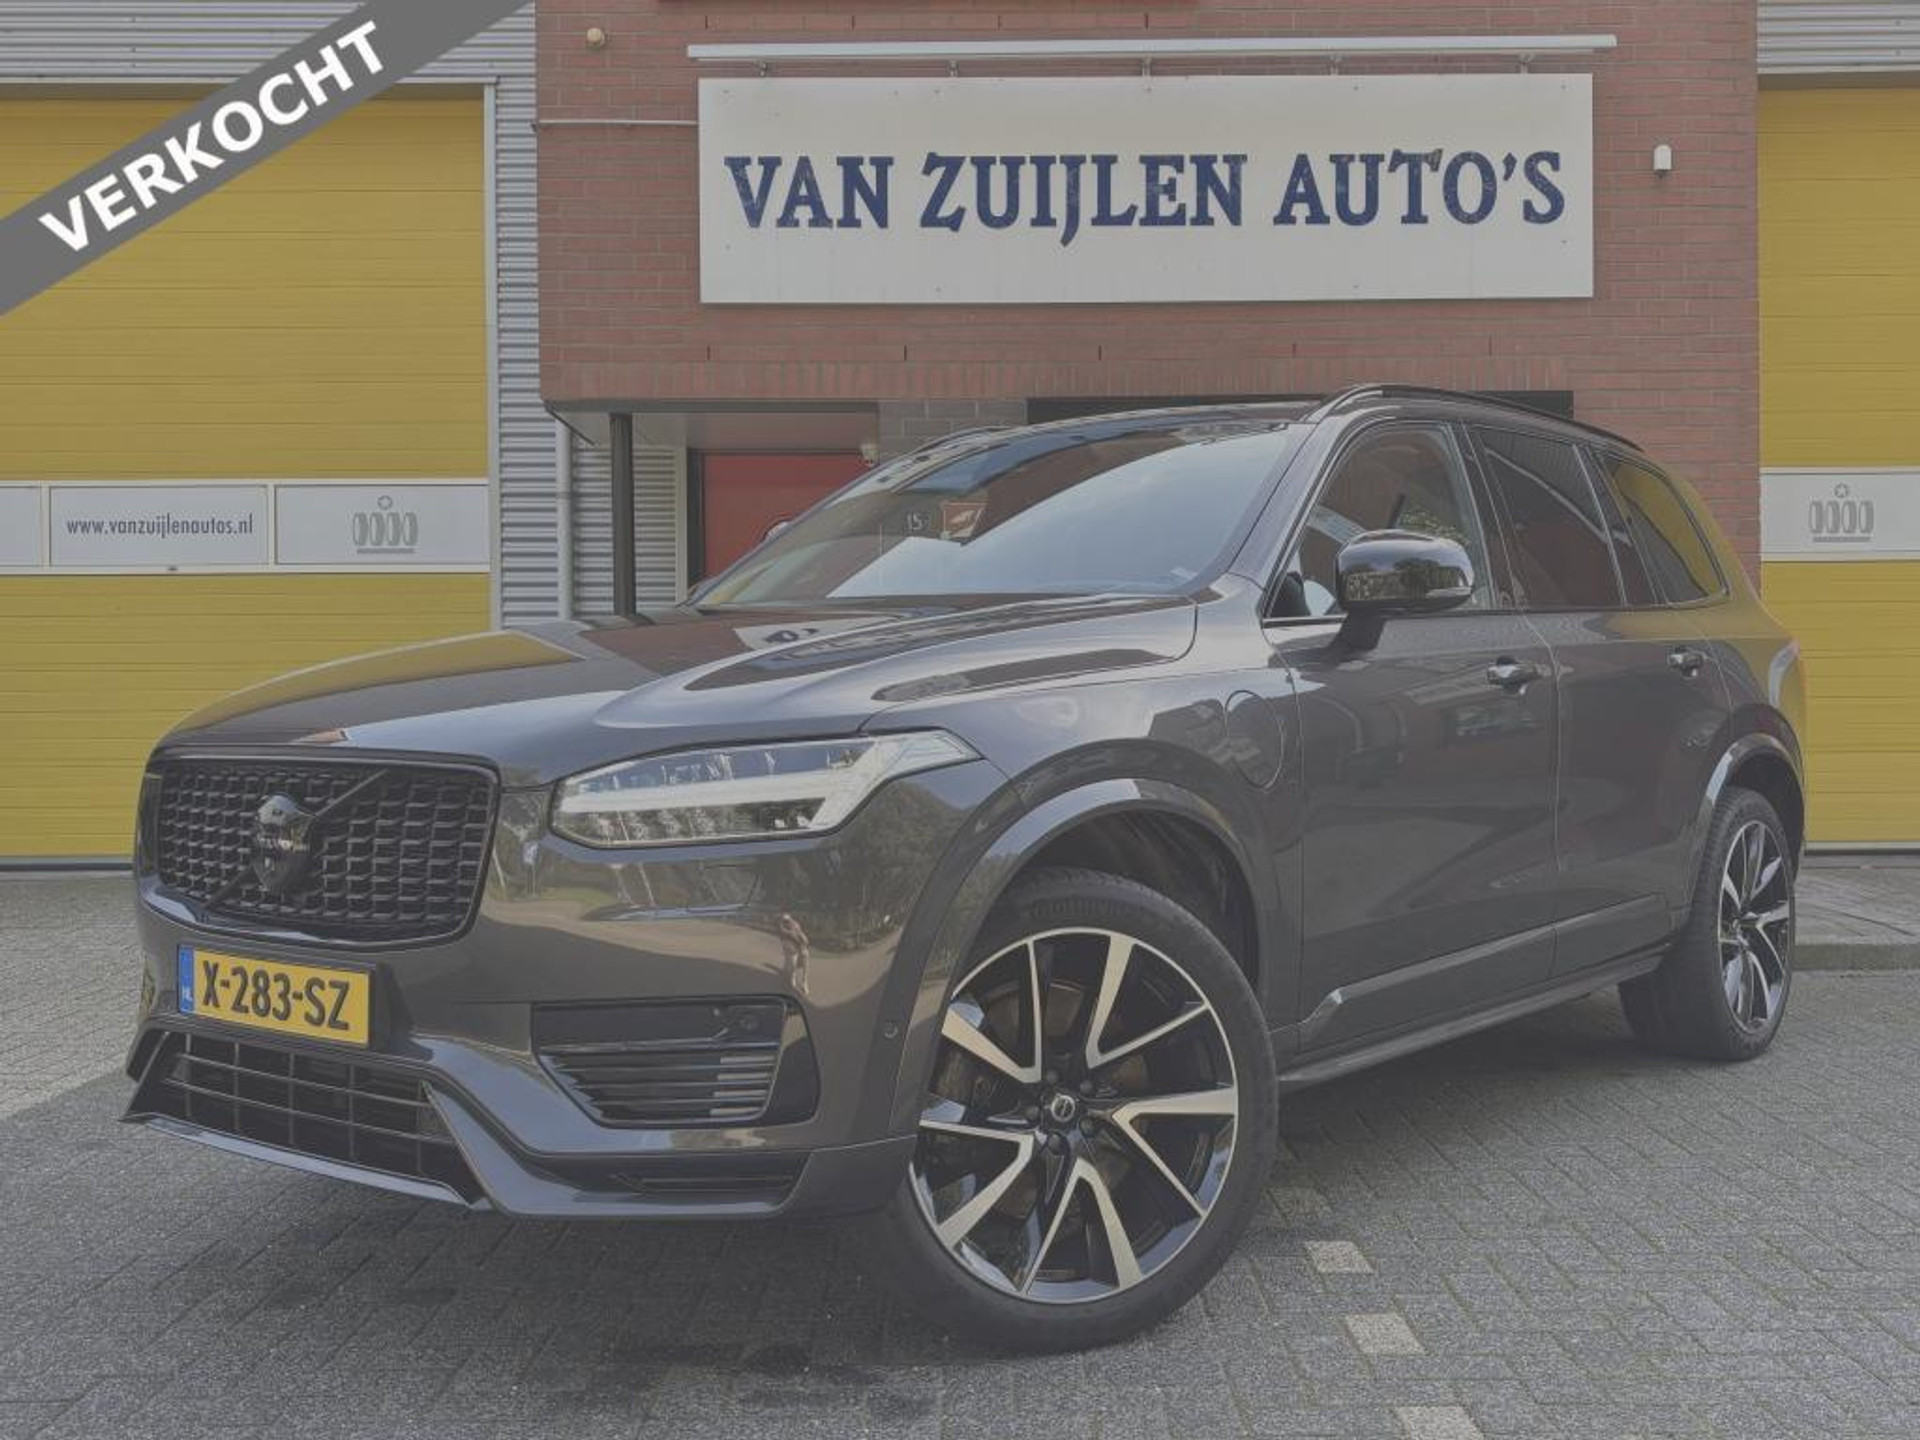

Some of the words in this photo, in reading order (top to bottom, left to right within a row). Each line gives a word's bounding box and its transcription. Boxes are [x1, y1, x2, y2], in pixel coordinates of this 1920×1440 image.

[724, 155, 895, 228] VAN
[919, 151, 1248, 247] ZUIJLEN
[1273, 148, 1566, 226] AUTO'S
[66, 513, 253, 539] www.vanzuijlenautos.nl
[203, 960, 350, 1030] X-283-SZ
